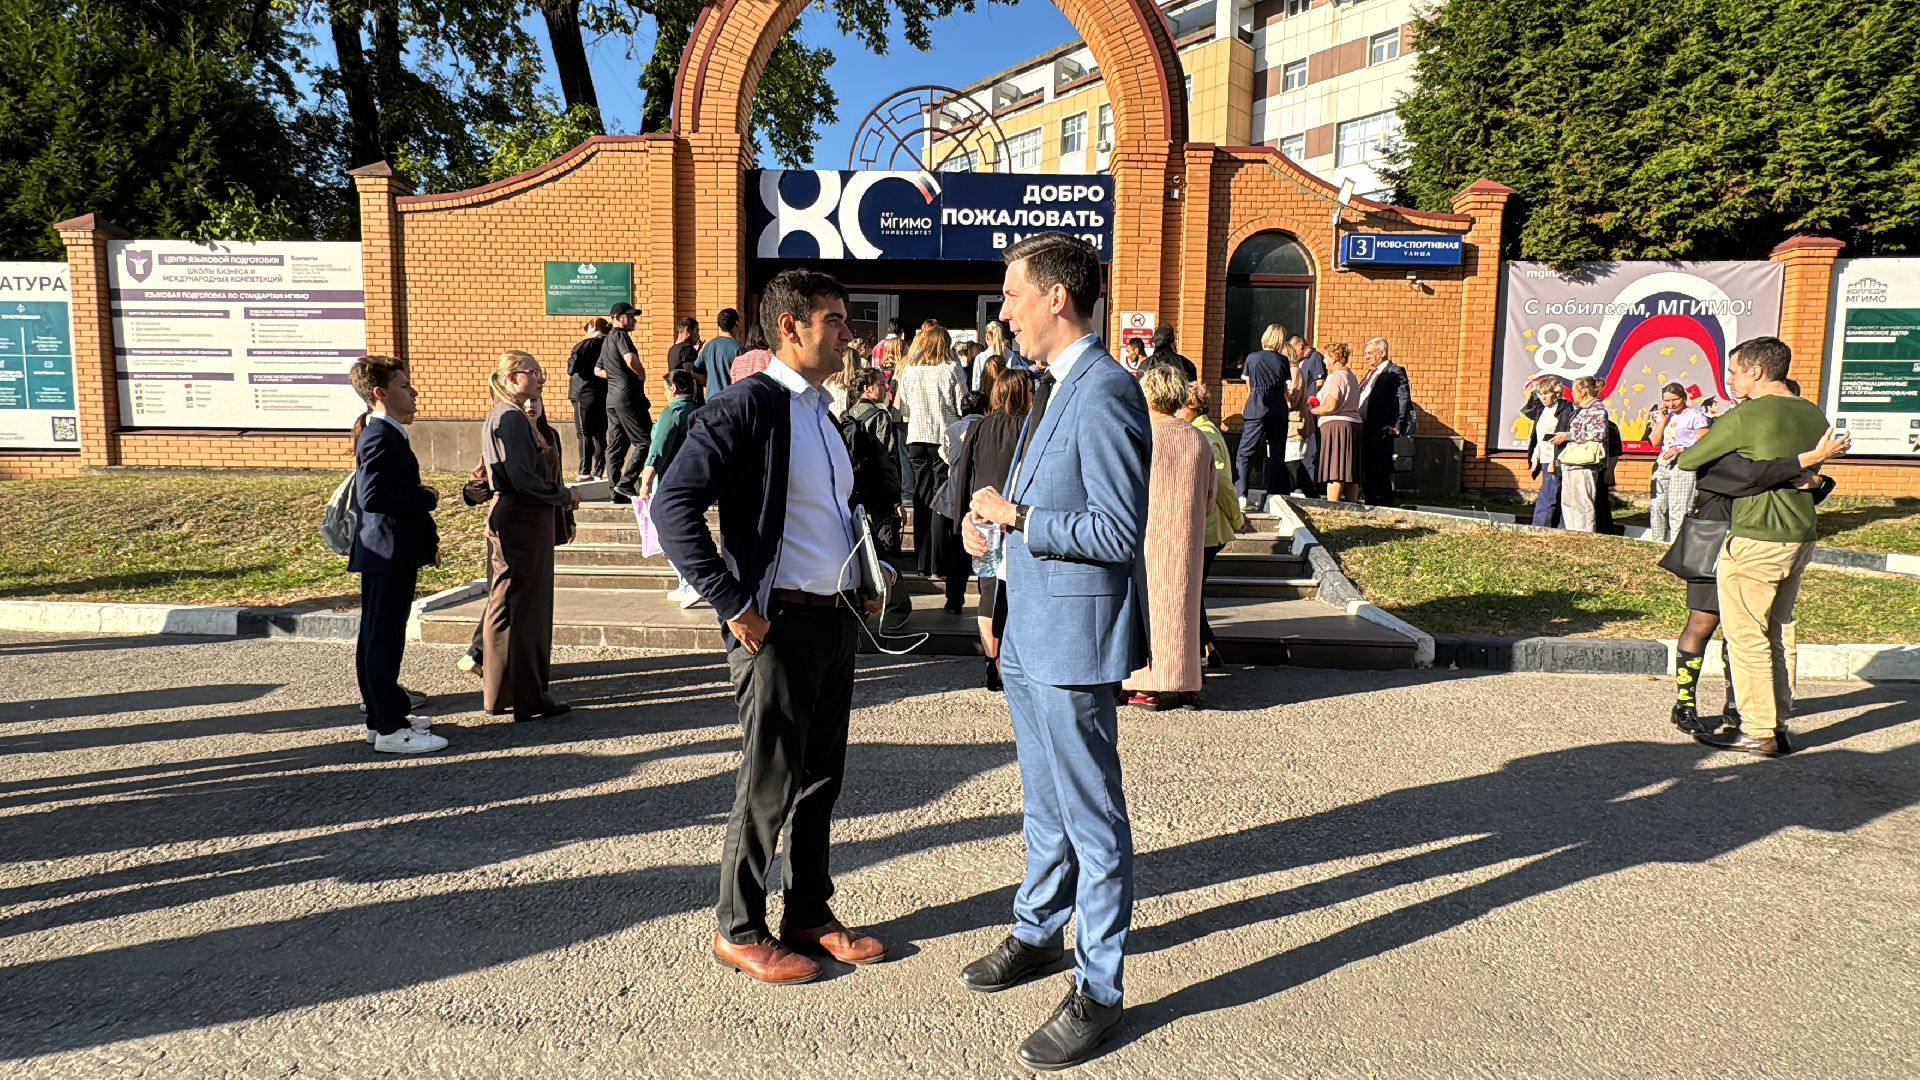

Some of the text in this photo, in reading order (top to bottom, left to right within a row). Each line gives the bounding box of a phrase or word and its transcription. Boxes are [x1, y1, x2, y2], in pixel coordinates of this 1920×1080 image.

[1023, 185, 1105, 204] ДОБРО
[880, 217, 932, 229] МГИМО
[942, 208, 1104, 226] ПОЖАЛОВАТЬ
[992, 232, 1008, 249] В
[1355, 239, 1367, 256] 3
[1376, 240, 1459, 250] НОВО-СПОРТИВНАЯ
[164, 255, 279, 264] ЦЕНТР ЯЗЫКОВОЙ ПОДГОТОВКИ
[163, 275, 229, 283] МЕЖДУНАРОДНЫХ
[231, 274, 283, 283] КОМПЕТЕНЦИЙ
[1846, 295, 1887, 303] МГИМО
[1524, 298, 1753, 318] С юбилеем, МГИМО!
